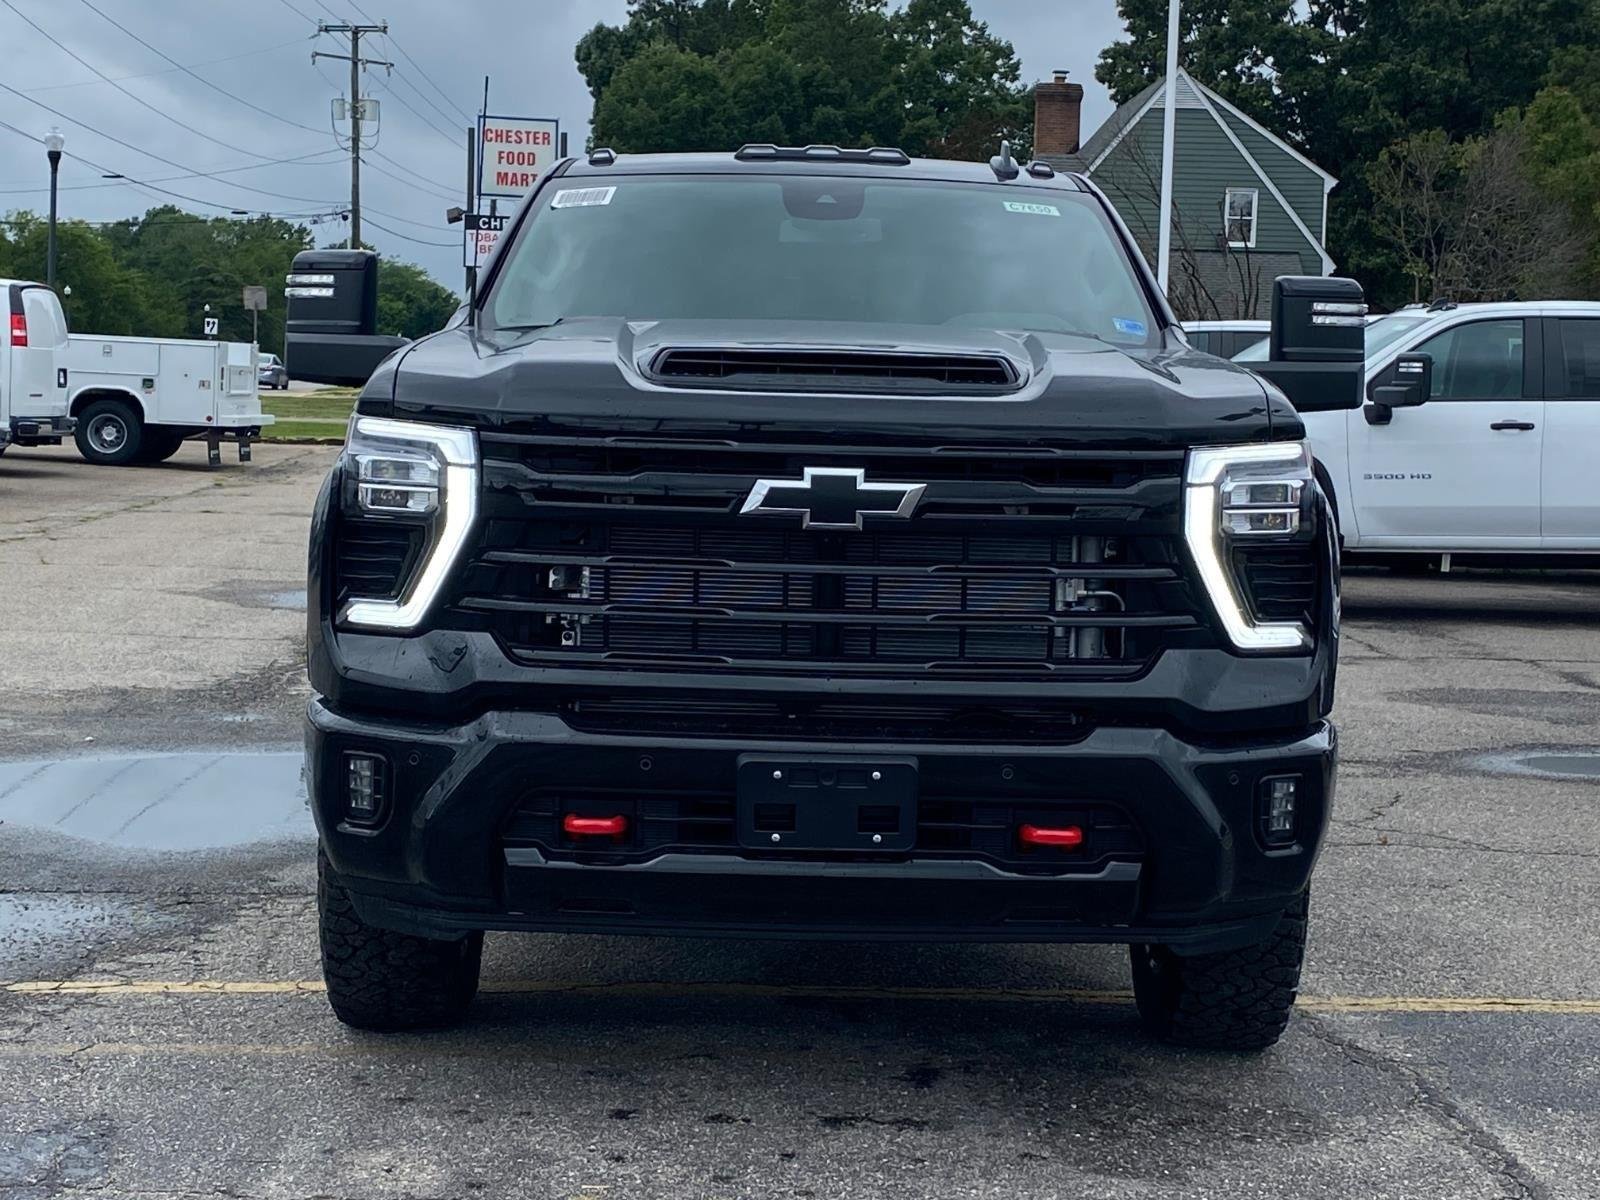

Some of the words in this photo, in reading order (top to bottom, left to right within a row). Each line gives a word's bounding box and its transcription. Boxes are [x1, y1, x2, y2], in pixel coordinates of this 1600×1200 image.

[485, 128, 551, 146] CHESTER
[497, 151, 536, 166] FOOD
[496, 172, 538, 187] MART
